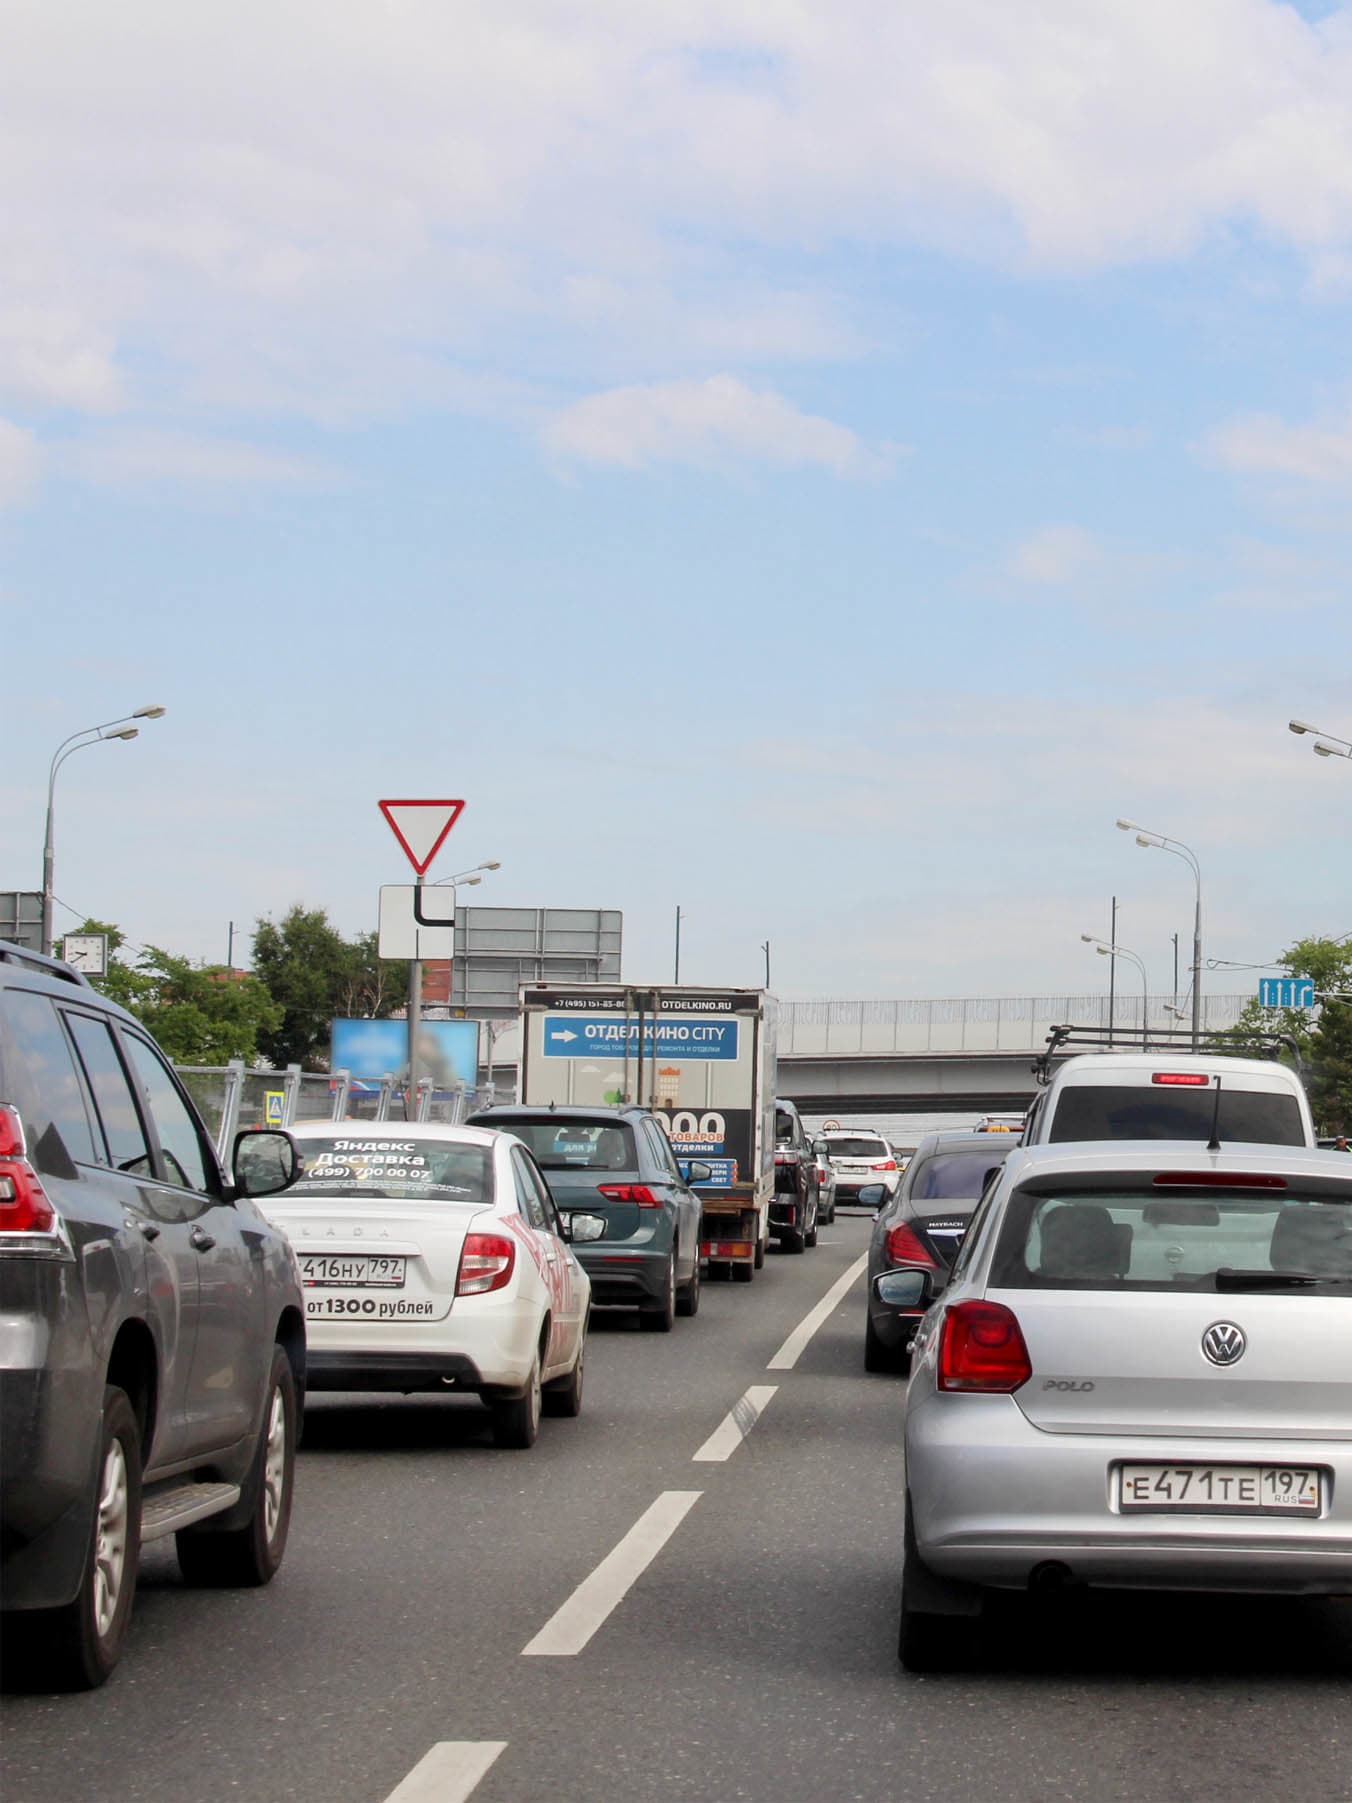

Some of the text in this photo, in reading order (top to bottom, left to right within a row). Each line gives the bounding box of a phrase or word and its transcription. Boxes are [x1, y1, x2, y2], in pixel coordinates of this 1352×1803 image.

[565, 1000, 586, 1008] (495)
[661, 1000, 732, 1010] OTDELKINO.RU
[692, 1027, 725, 1040] CITY
[670, 1132, 723, 1141] ТОВАРОВ
[333, 1140, 416, 1152] Яндекс
[672, 1144, 714, 1152] отделки
[315, 1153, 425, 1166] Доставка
[308, 1168, 432, 1178] (499) 700 00 07
[303, 1259, 399, 1278] 416НУ 797
[307, 1299, 433, 1316] от 1300 рублей
[1042, 1379, 1095, 1393] POLO
[1264, 1472, 1309, 1495] 197
[1274, 1494, 1297, 1504] RUS
